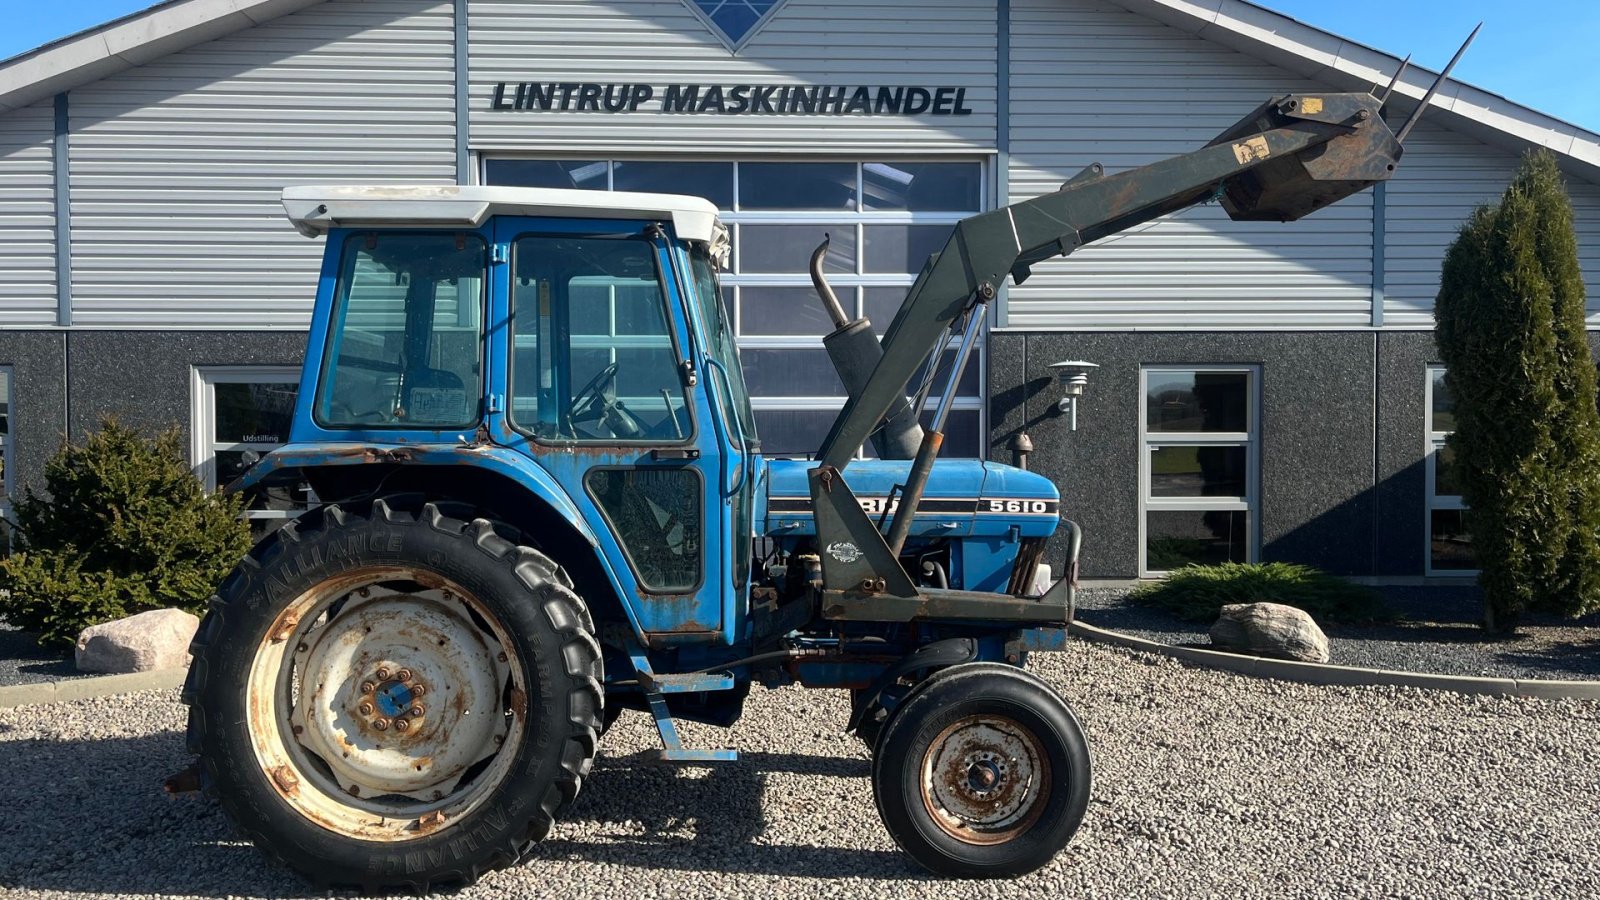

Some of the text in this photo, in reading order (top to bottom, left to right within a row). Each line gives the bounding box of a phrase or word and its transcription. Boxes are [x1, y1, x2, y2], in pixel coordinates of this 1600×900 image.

[493, 82, 972, 115] LINTRUP MASKINHANDEL
[242, 434, 279, 443] Udstilling
[857, 498, 900, 513] RD
[989, 499, 1047, 513] 5610
[263, 532, 403, 606] ALLIANCE
[368, 802, 510, 875] ALLIANCE
